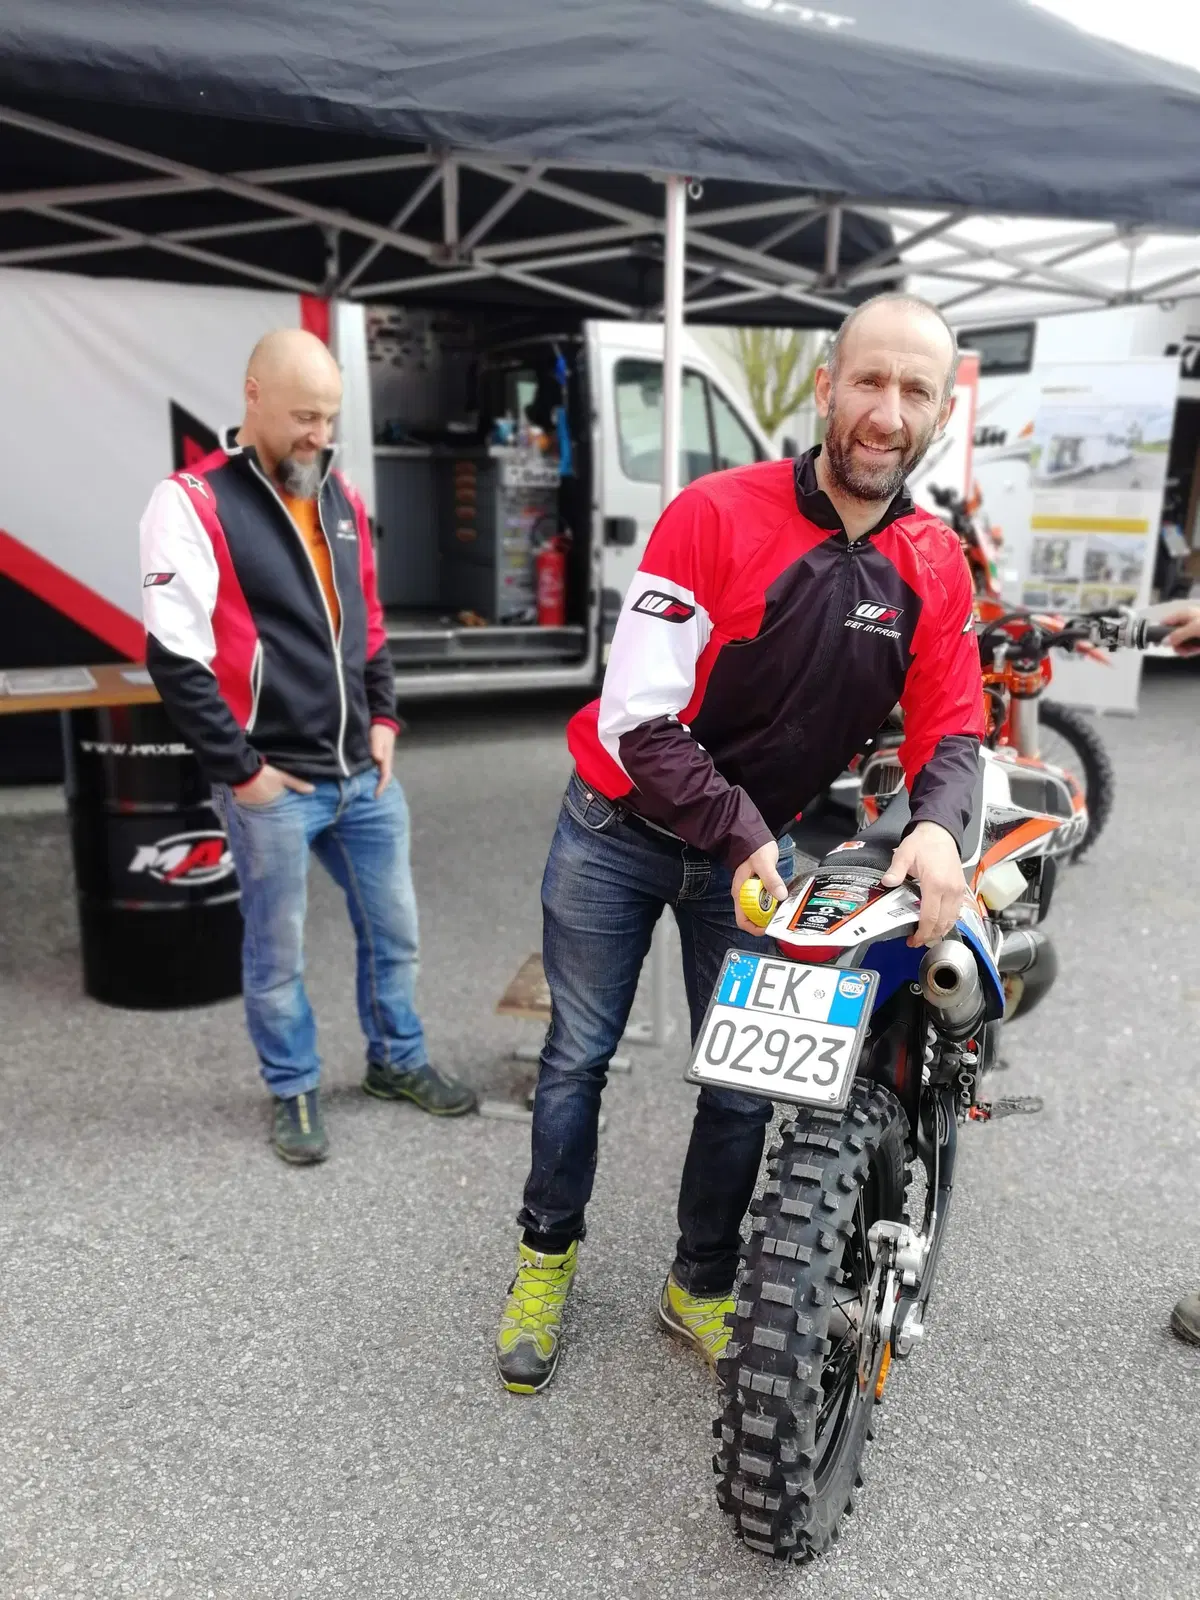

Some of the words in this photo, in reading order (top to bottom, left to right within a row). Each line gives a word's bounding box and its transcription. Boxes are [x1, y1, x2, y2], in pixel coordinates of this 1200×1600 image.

[637, 593, 693, 617] WP
[855, 603, 899, 623] WP
[844, 619, 865, 631] GET
[862, 624, 875, 634] IN
[873, 626, 902, 640] FRONT
[751, 962, 813, 1014] EK
[704, 1019, 847, 1087] 02923
